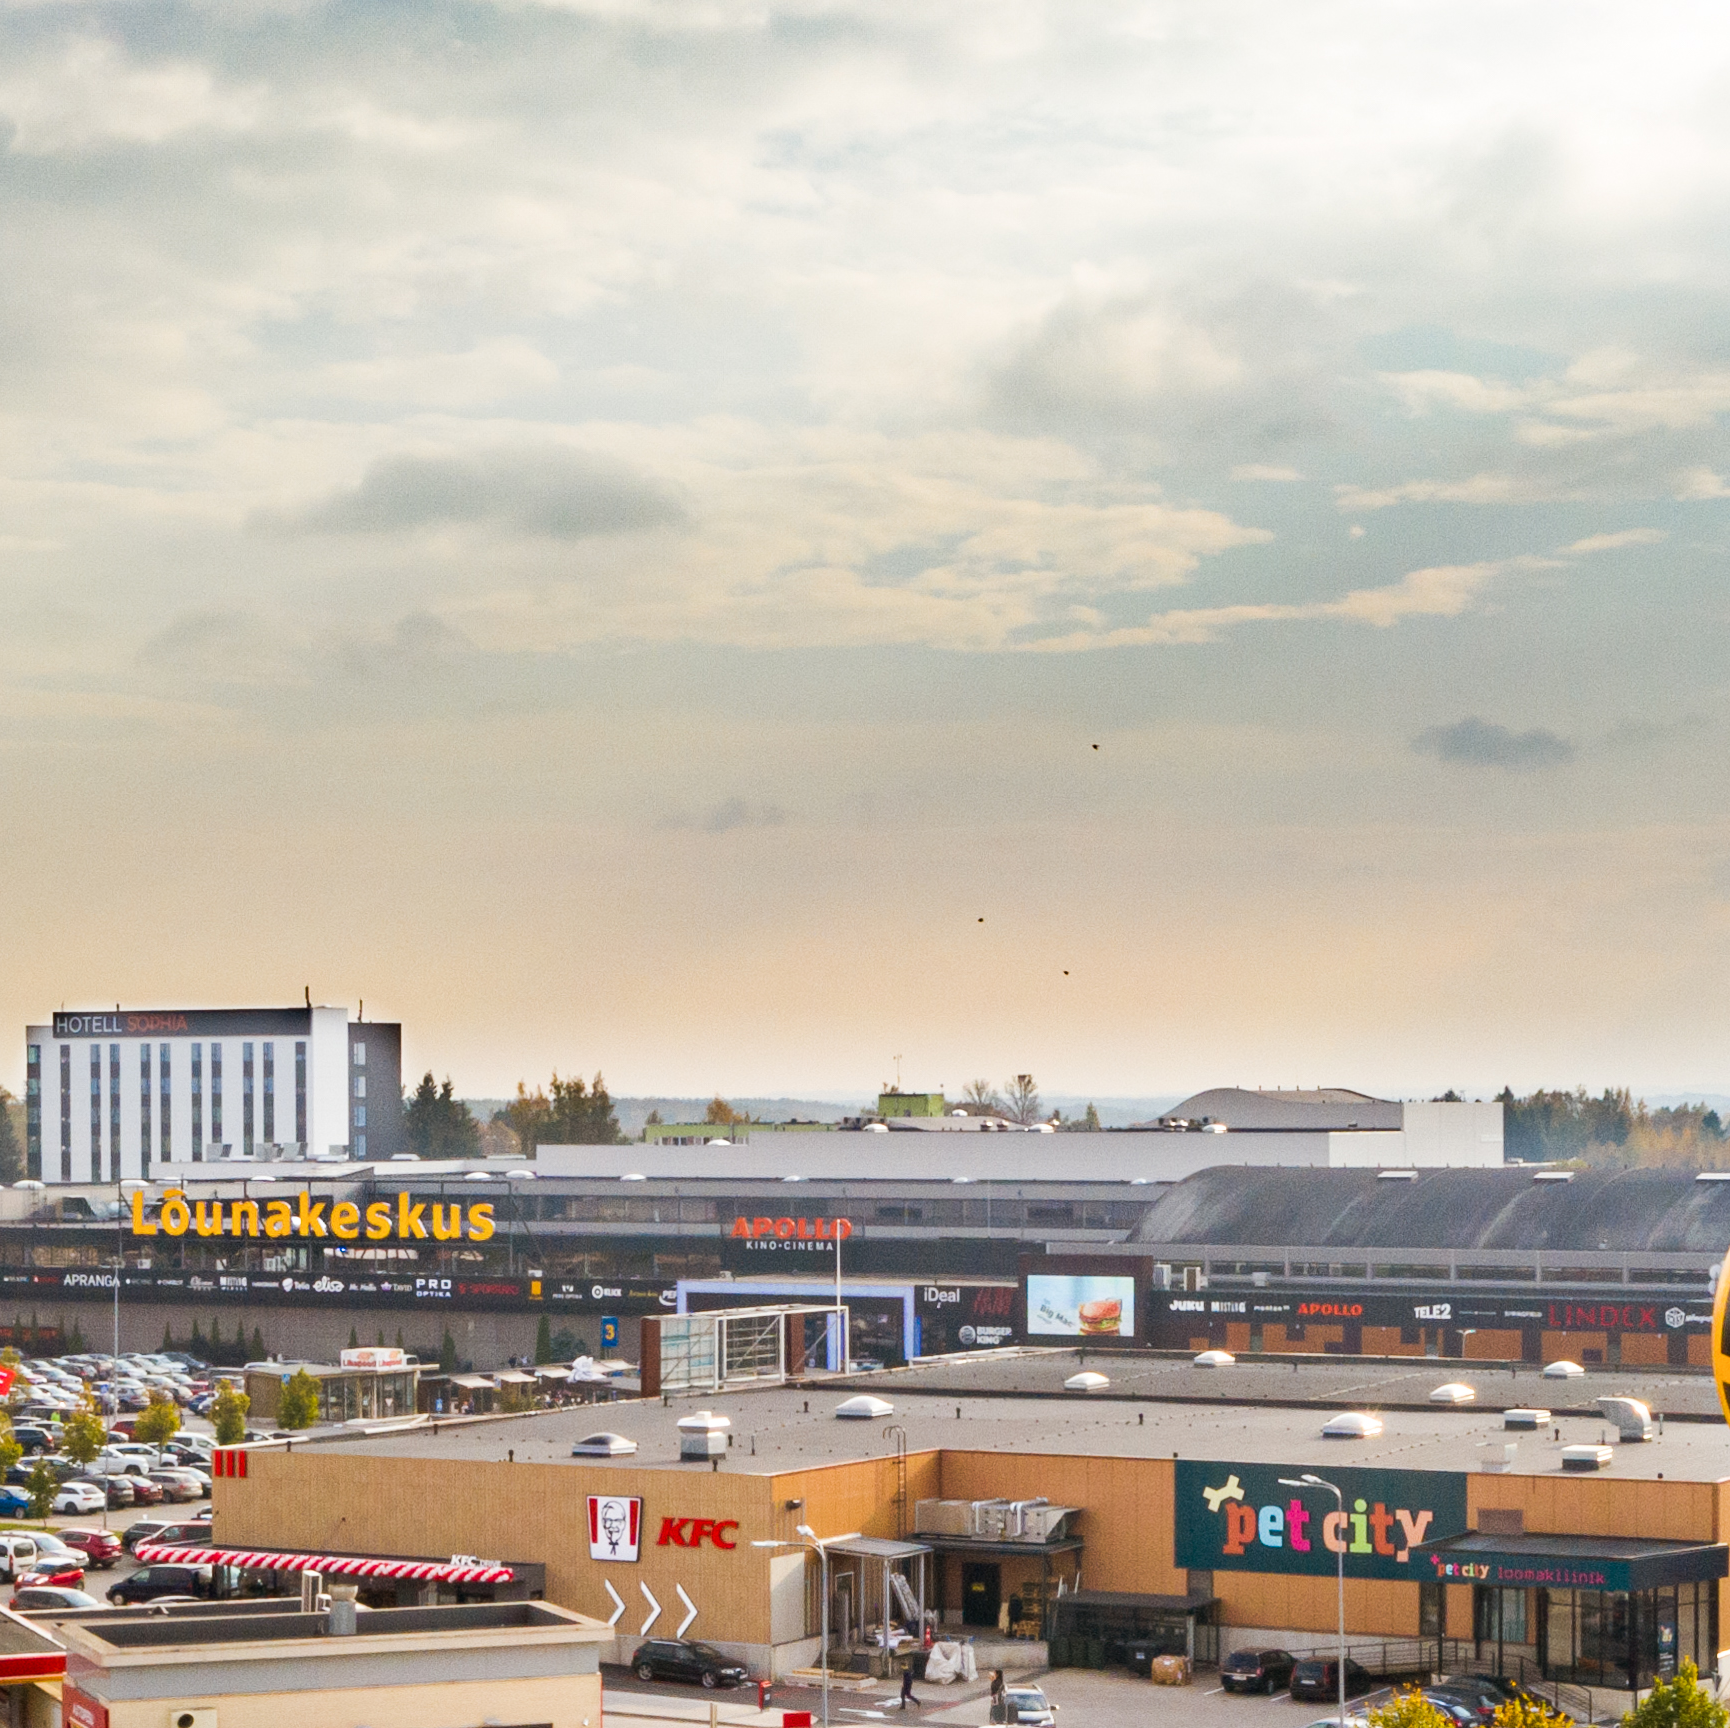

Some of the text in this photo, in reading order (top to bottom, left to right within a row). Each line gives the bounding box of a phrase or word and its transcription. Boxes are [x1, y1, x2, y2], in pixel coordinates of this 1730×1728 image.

[56, 1016, 122, 1033] HOTELL
[131, 1188, 496, 1242] Lõunakeskus
[731, 1217, 853, 1240] APOLLO
[64, 1273, 120, 1288] APRANGA
[313, 1275, 345, 1292] elisa
[416, 1279, 452, 1290] PRO
[924, 1287, 960, 1303] iDeal
[1298, 1303, 1363, 1316] APOLLO
[1414, 1303, 1452, 1320] TELE2
[605, 1324, 615, 1340] 3
[976, 1326, 1012, 1336] BURGER
[976, 1336, 1001, 1345] KING
[657, 1517, 739, 1550] KFC
[1222, 1498, 1433, 1563] pet city
[1436, 1562, 1606, 1584] pet city loomakliinik
